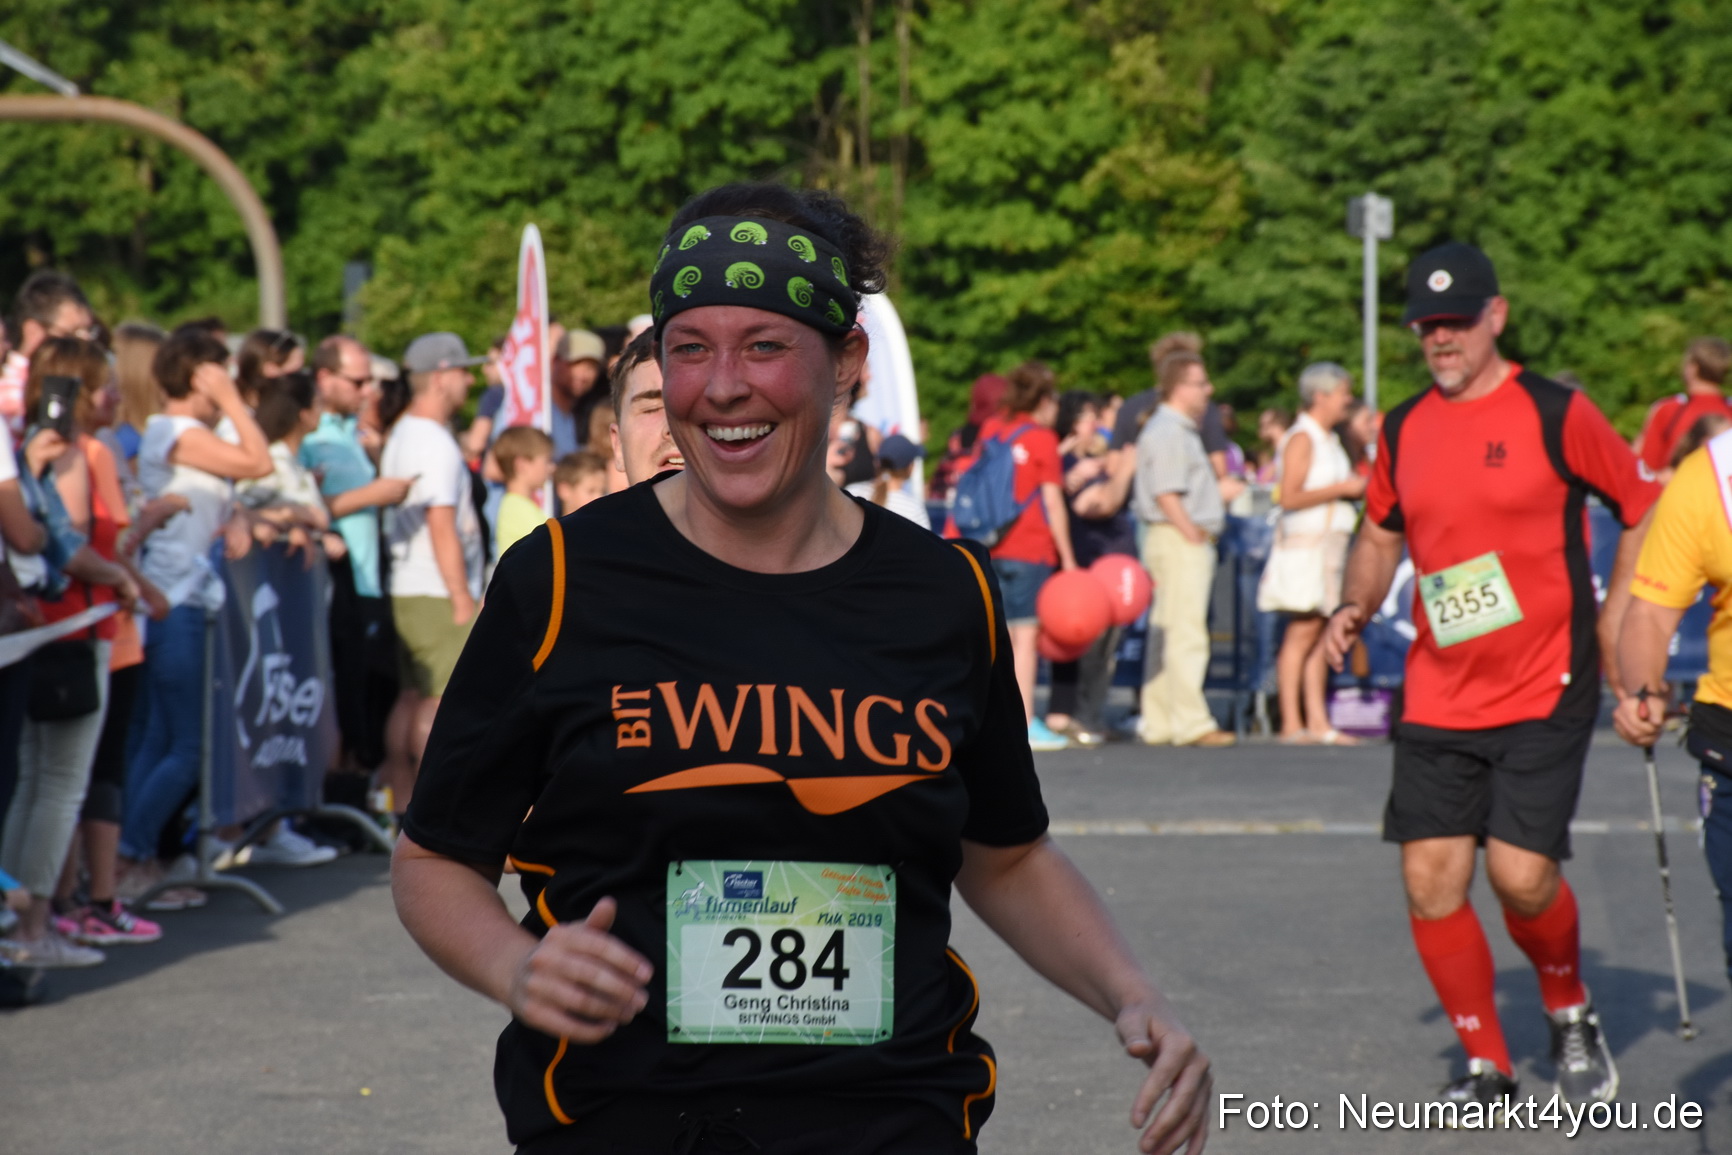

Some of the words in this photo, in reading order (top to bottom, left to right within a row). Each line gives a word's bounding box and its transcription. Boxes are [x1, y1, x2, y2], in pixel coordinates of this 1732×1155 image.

[1433, 583, 1499, 624] 2355
[611, 684, 652, 750] BIT
[655, 680, 952, 772] WINGS
[705, 896, 799, 914] firmenlauf
[847, 912, 883, 927] 2019
[721, 928, 850, 991] 284
[723, 994, 771, 1012] Geng
[777, 994, 850, 1012] Christina
[738, 1013, 800, 1025] BITWINGS
[802, 1014, 837, 1026] GmbH
